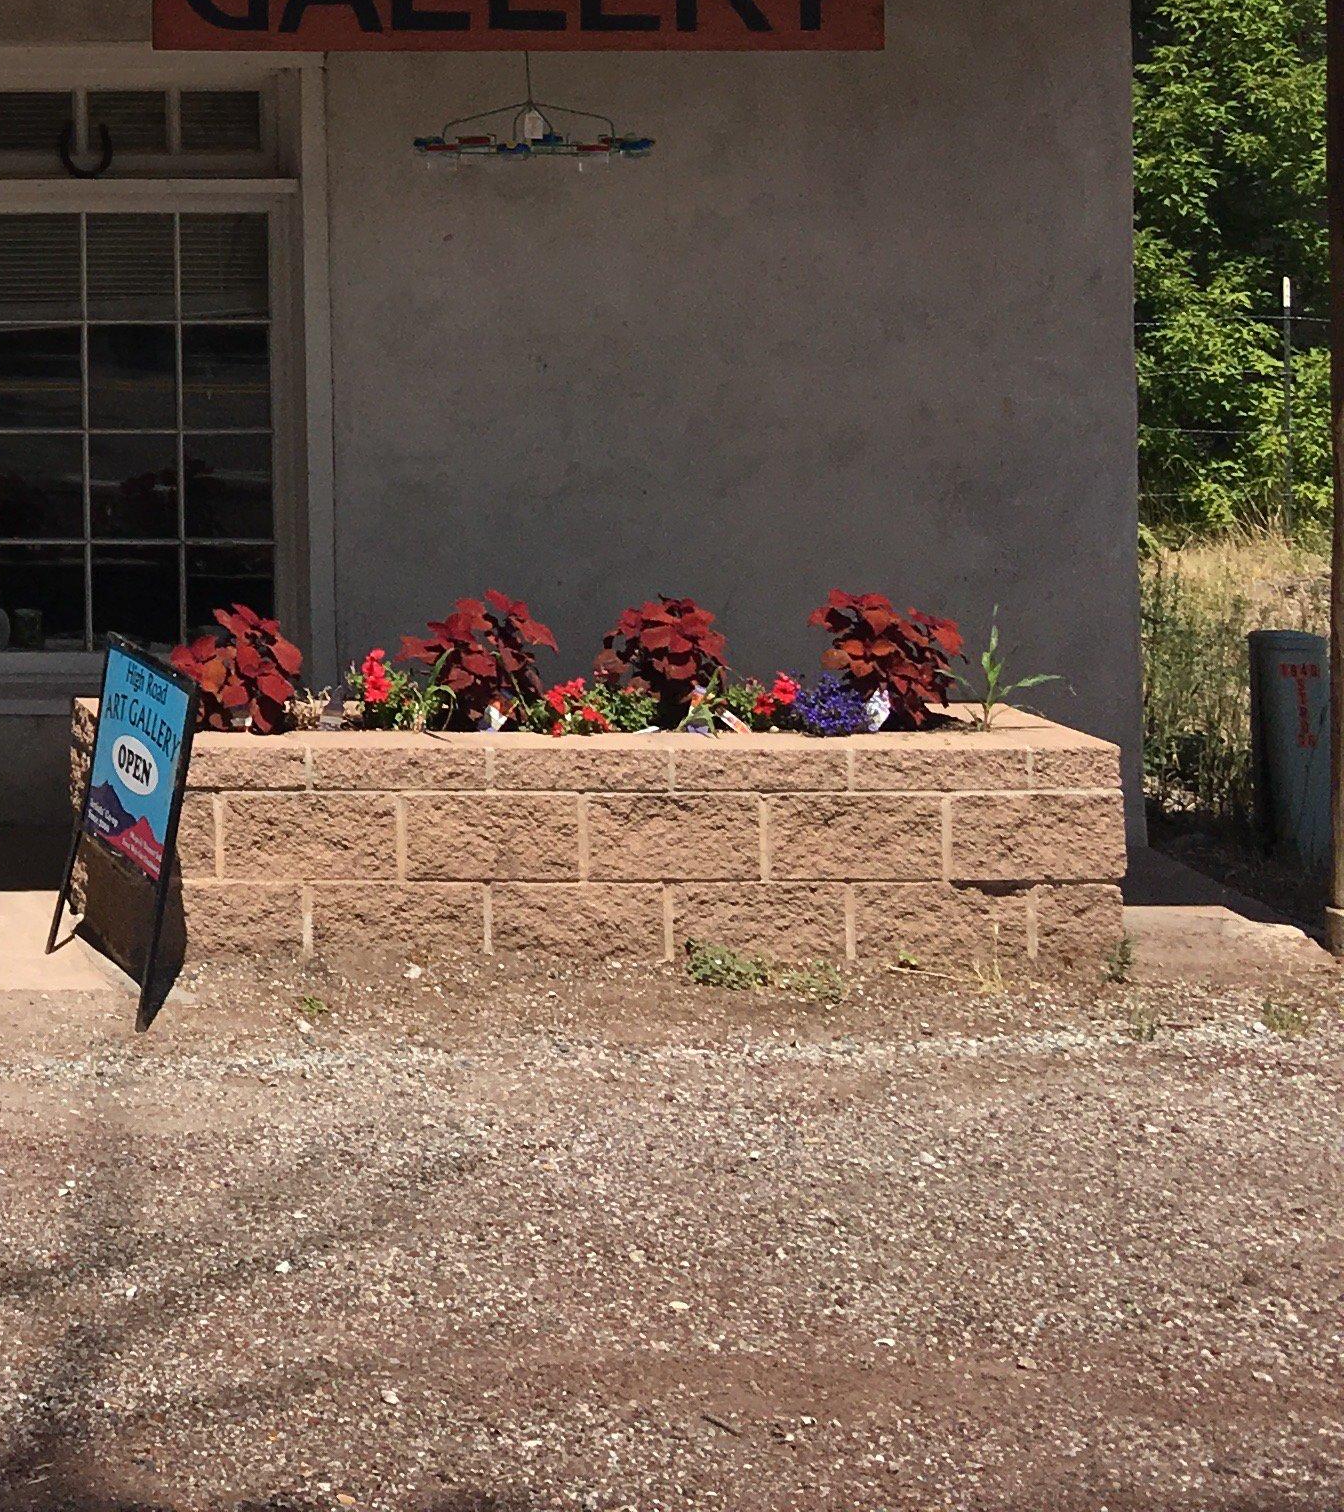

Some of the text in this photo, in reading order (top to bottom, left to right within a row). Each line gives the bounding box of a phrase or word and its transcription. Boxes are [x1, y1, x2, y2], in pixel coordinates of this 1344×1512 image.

[126, 660, 169, 706] High Road
[105, 692, 181, 762] ART GALLERY
[117, 744, 152, 787] OPEN
